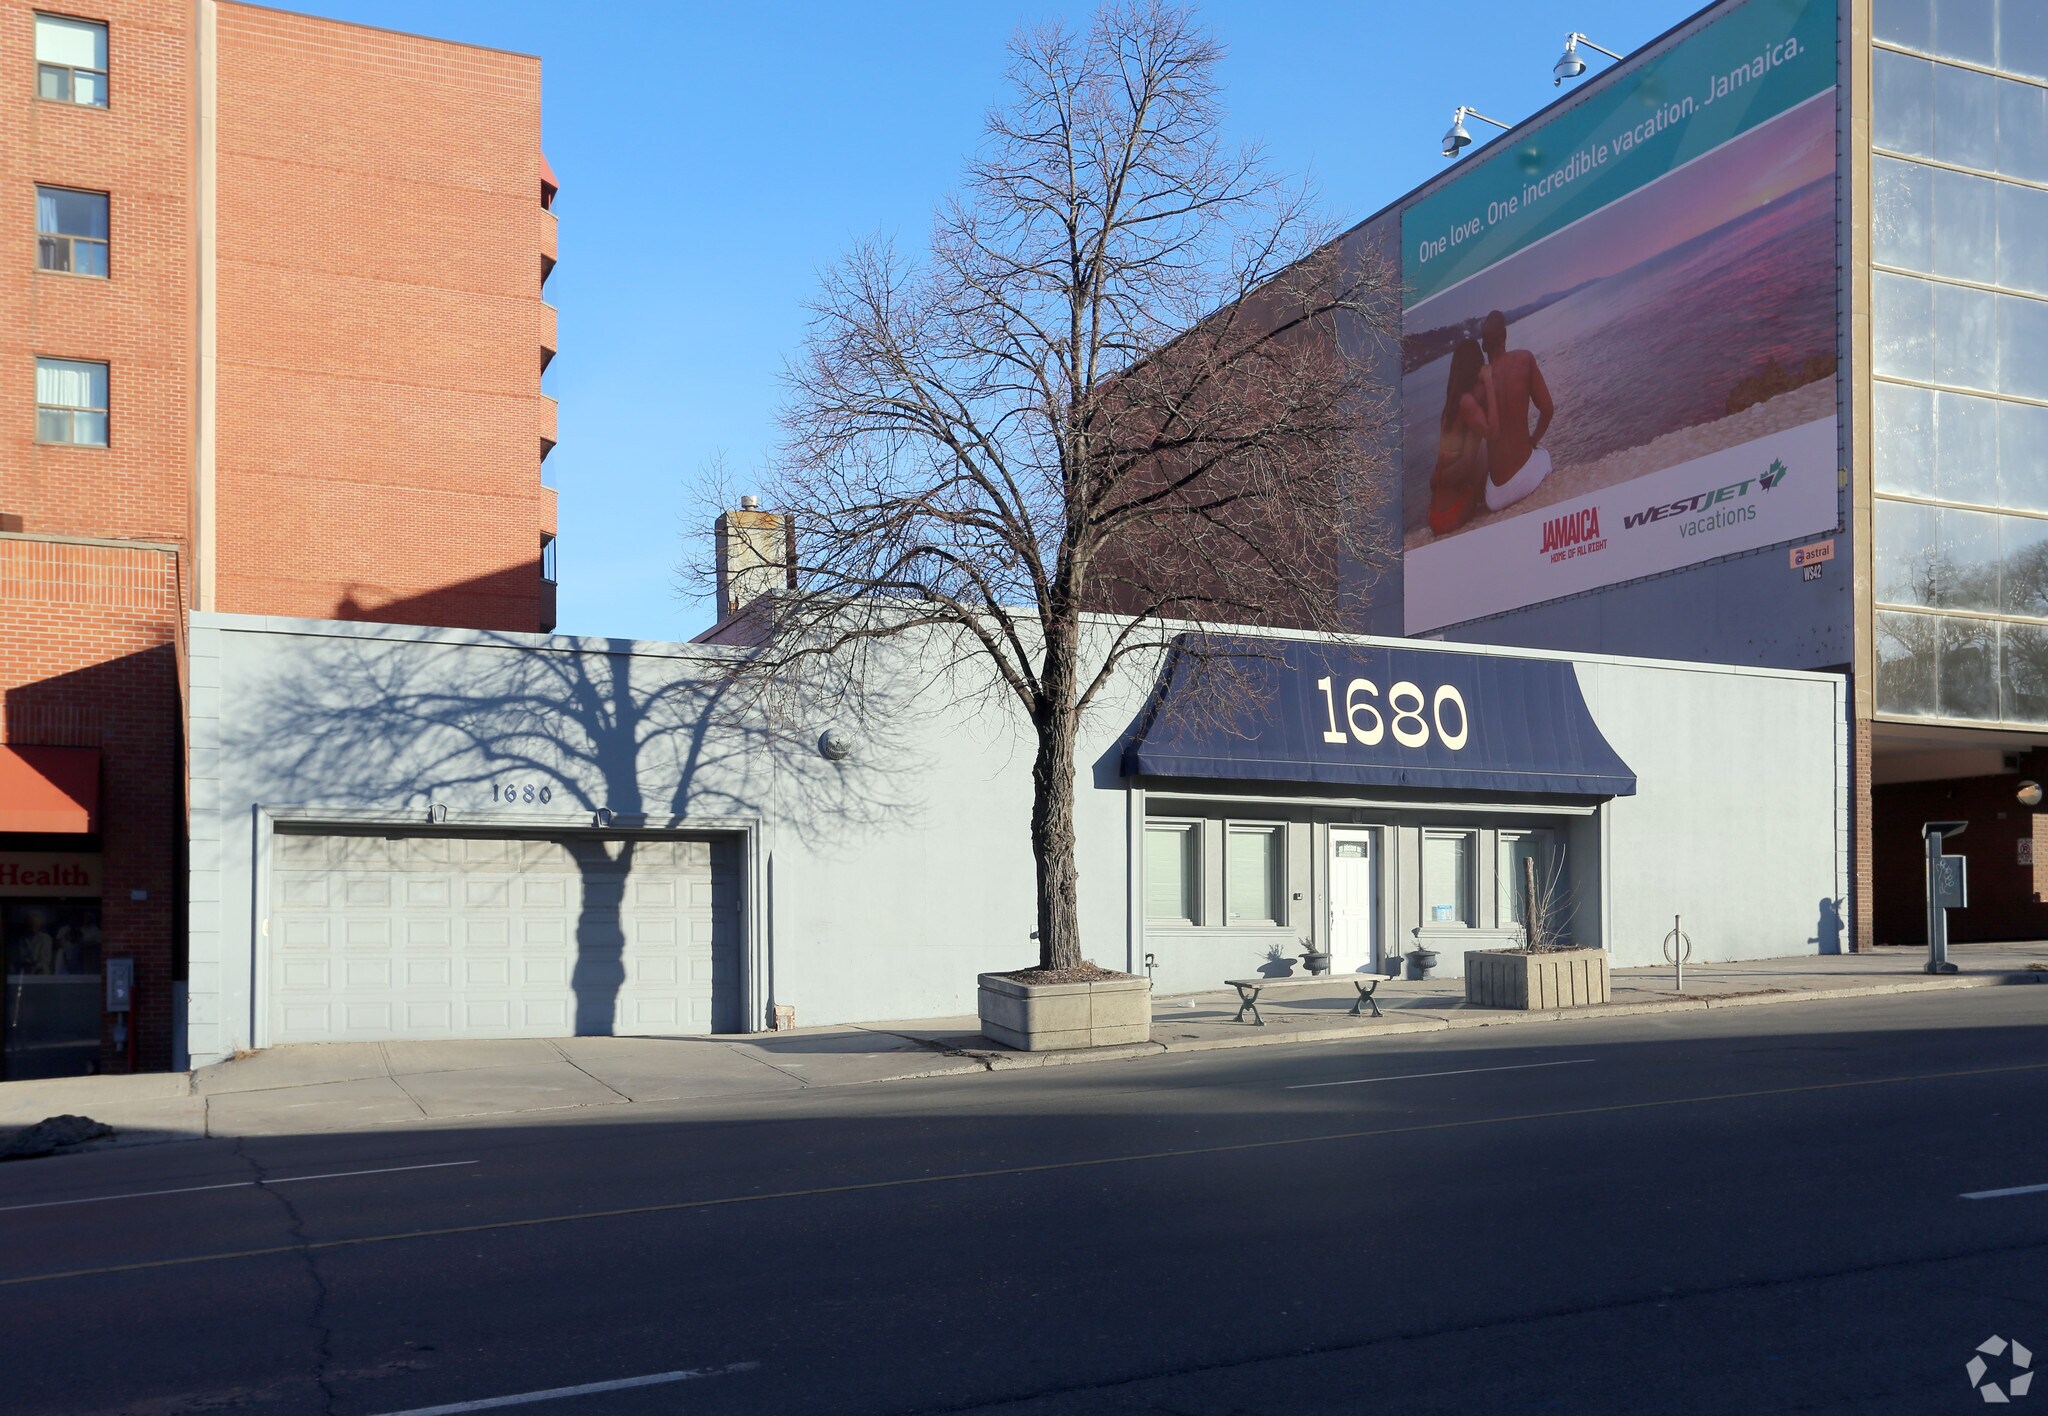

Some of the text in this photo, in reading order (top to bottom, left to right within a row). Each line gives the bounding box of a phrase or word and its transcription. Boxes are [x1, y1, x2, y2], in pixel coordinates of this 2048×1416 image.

[1420, 37, 1804, 263] One love. One incredible vacation. Jamaica.
[1623, 479, 1756, 529] WESTJET
[1679, 504, 1757, 538] vacations
[1540, 507, 1600, 554] JAMAICA
[1588, 539, 1608, 553] RIGHT
[1806, 545, 1829, 559] astral
[1317, 676, 1468, 750] 1680
[493, 783, 551, 804] 1680
[0, 864, 89, 886] Health
